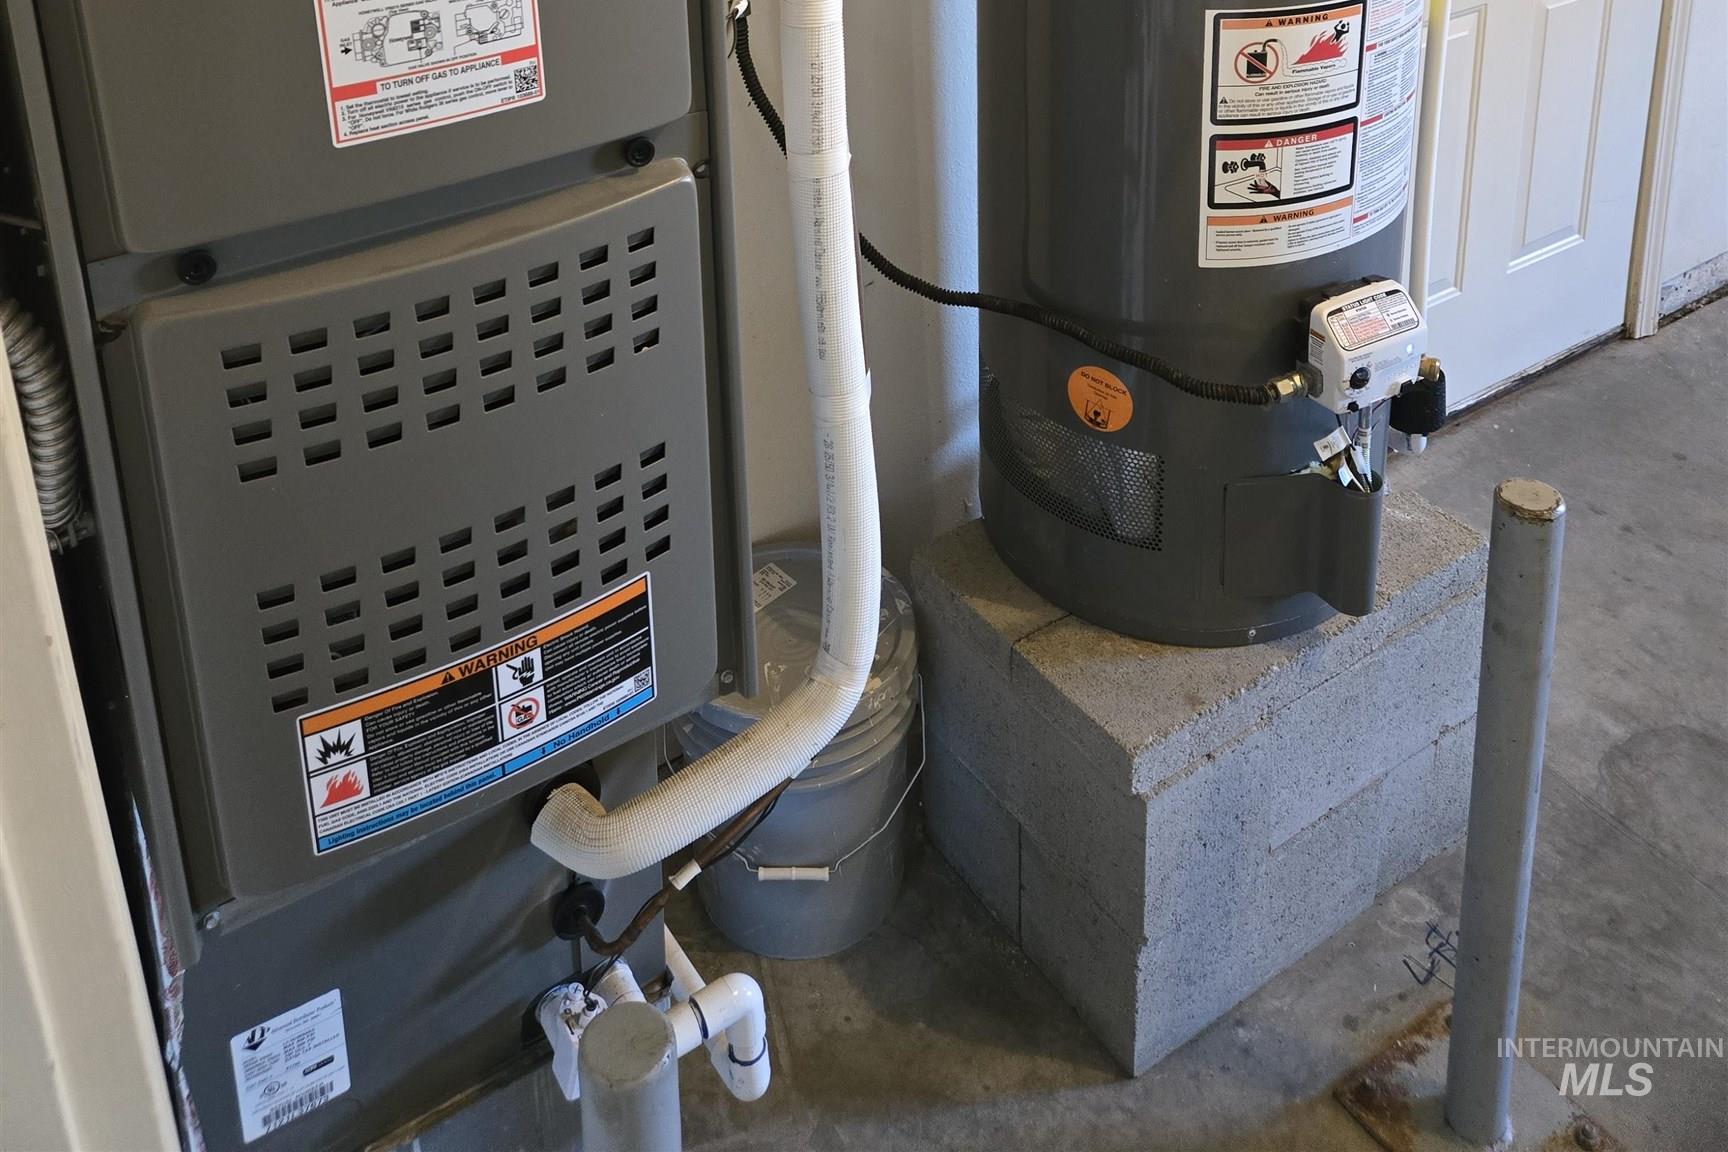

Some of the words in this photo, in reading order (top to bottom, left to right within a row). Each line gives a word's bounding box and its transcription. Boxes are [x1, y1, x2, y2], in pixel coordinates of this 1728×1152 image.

[1278, 14, 1328, 28] WARNING
[380, 82, 390, 91] TO
[390, 76, 414, 89] TURN
[415, 73, 430, 83] OFF
[432, 70, 447, 80] GAS
[449, 67, 459, 76] TO
[460, 57, 500, 74] APPLIANCE
[1276, 134, 1317, 147] DANGER
[1273, 210, 1315, 223] WARNING
[1343, 303, 1359, 311] STATUS
[1360, 297, 1373, 306] LIGHT
[1374, 293, 1387, 301] CODE
[1081, 371, 1090, 379] DO
[1091, 376, 1104, 385] NOT
[1105, 384, 1127, 396] BLOCK
[458, 634, 537, 678] WARNING
[553, 737, 565, 748] No
[568, 713, 609, 741] Handhold
[328, 828, 356, 846] Lighting
[356, 813, 394, 835] instructions
[395, 807, 409, 820] may
[410, 804, 418, 814] be
[419, 793, 442, 811] located
[443, 784, 464, 801] behind
[465, 778, 477, 791] this
[478, 769, 496, 785] panel.
